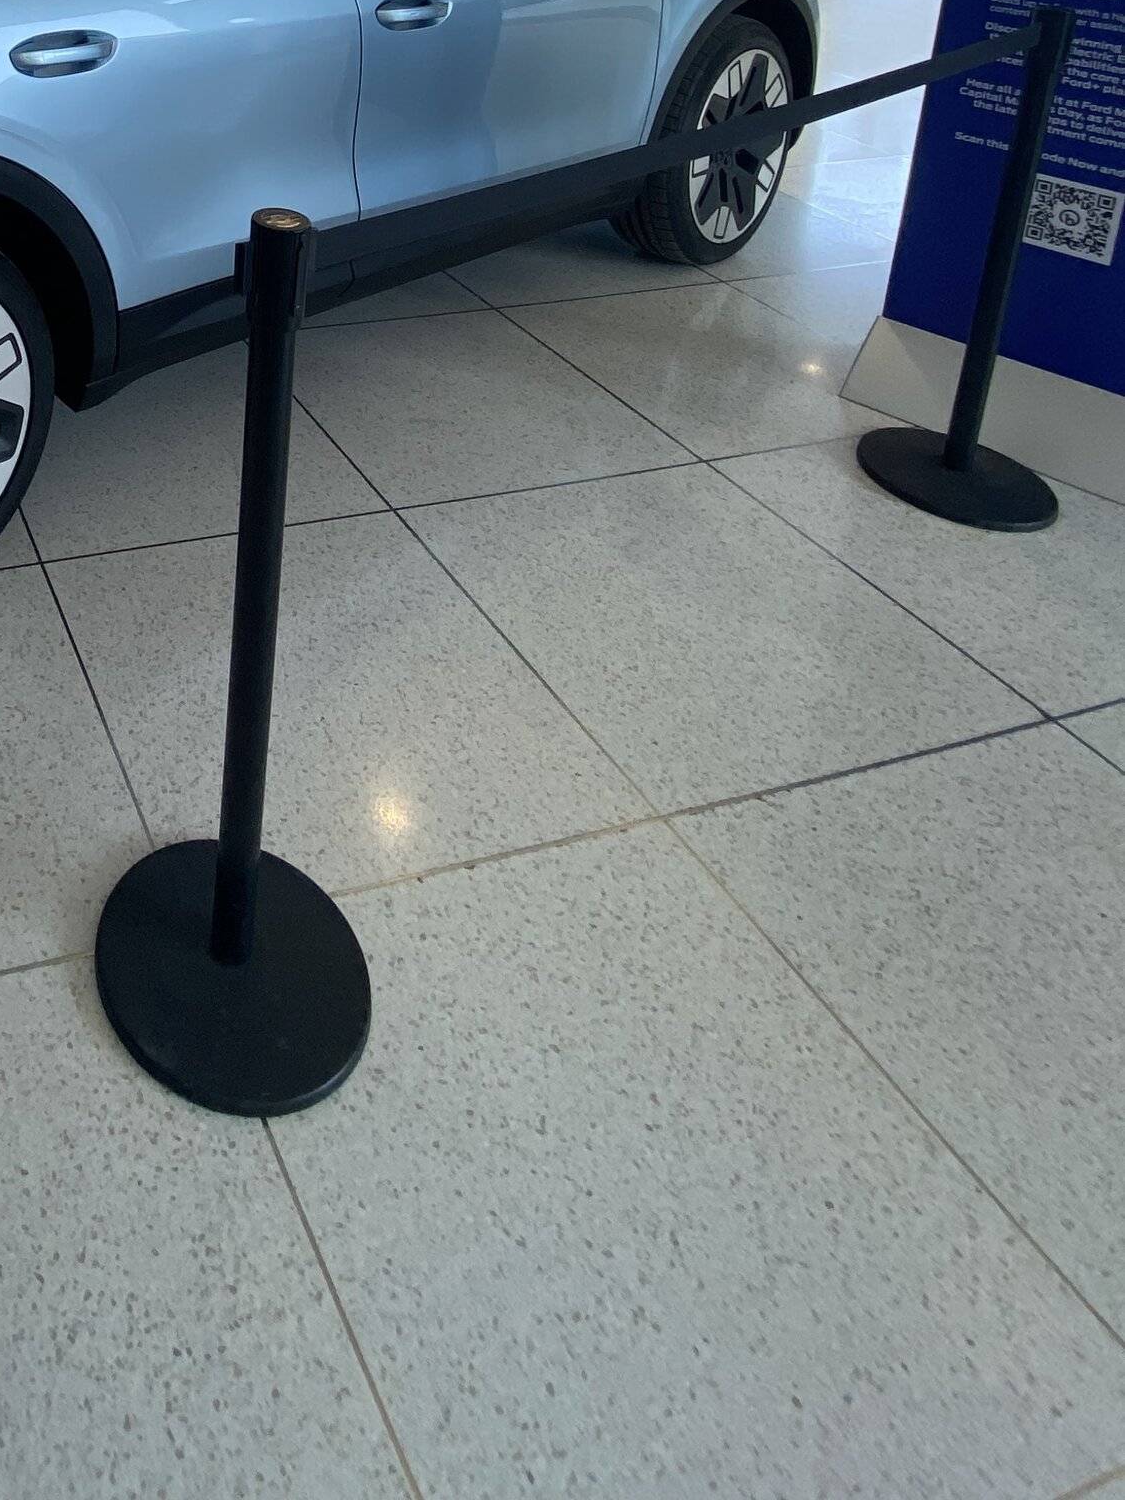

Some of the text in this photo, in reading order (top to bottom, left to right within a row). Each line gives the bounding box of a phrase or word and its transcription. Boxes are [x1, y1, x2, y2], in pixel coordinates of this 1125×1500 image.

[959, 86, 1003, 103] Capital
[1087, 114, 1104, 124] as
[966, 78, 995, 91] Hear
[996, 84, 1013, 95] all
[1081, 100, 1113, 115] Ford
[973, 99, 994, 111] the
[1070, 120, 1085, 131] to
[954, 131, 984, 146] Scan
[986, 138, 1010, 151] this
[1040, 152, 1066, 165] ode
[1067, 156, 1098, 172] Now
